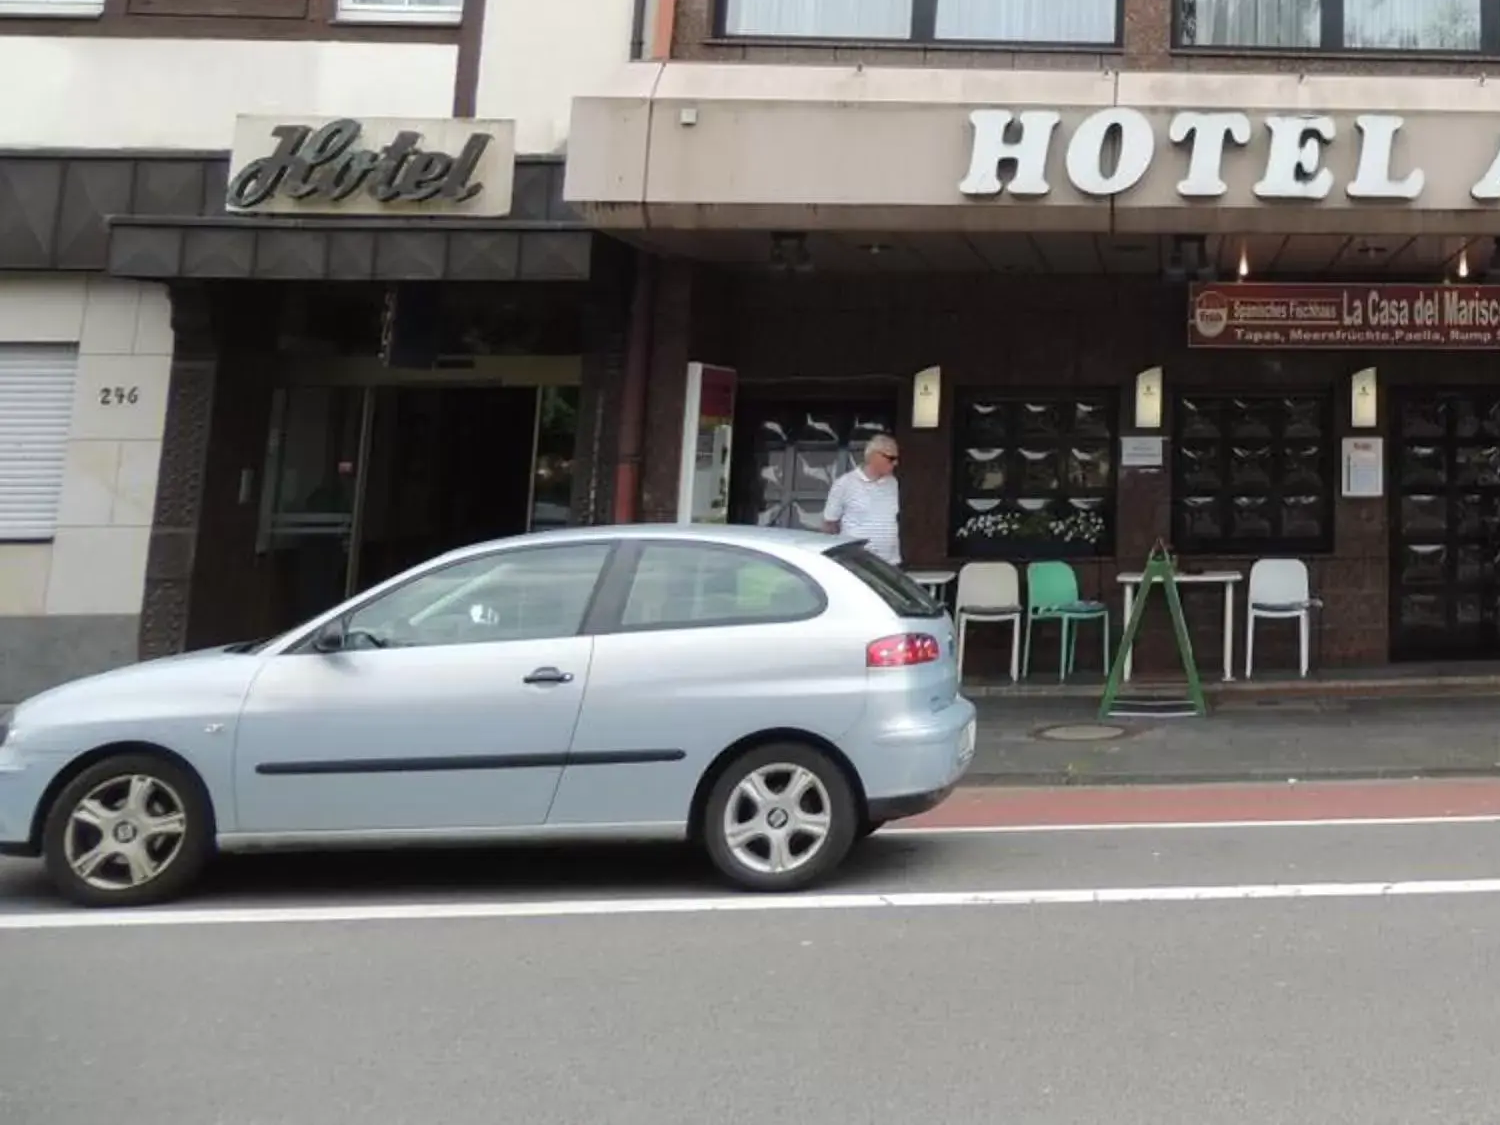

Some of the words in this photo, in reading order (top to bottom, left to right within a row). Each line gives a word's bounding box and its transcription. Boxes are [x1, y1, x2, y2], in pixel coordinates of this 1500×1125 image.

[225, 118, 494, 208] Hotel
[958, 107, 1425, 201] HOTEL
[1343, 290, 1363, 325] La
[1367, 290, 1410, 326] Casa
[1414, 291, 1440, 325] del
[1451, 329, 1492, 343] Rump
[100, 386, 139, 405] 246
